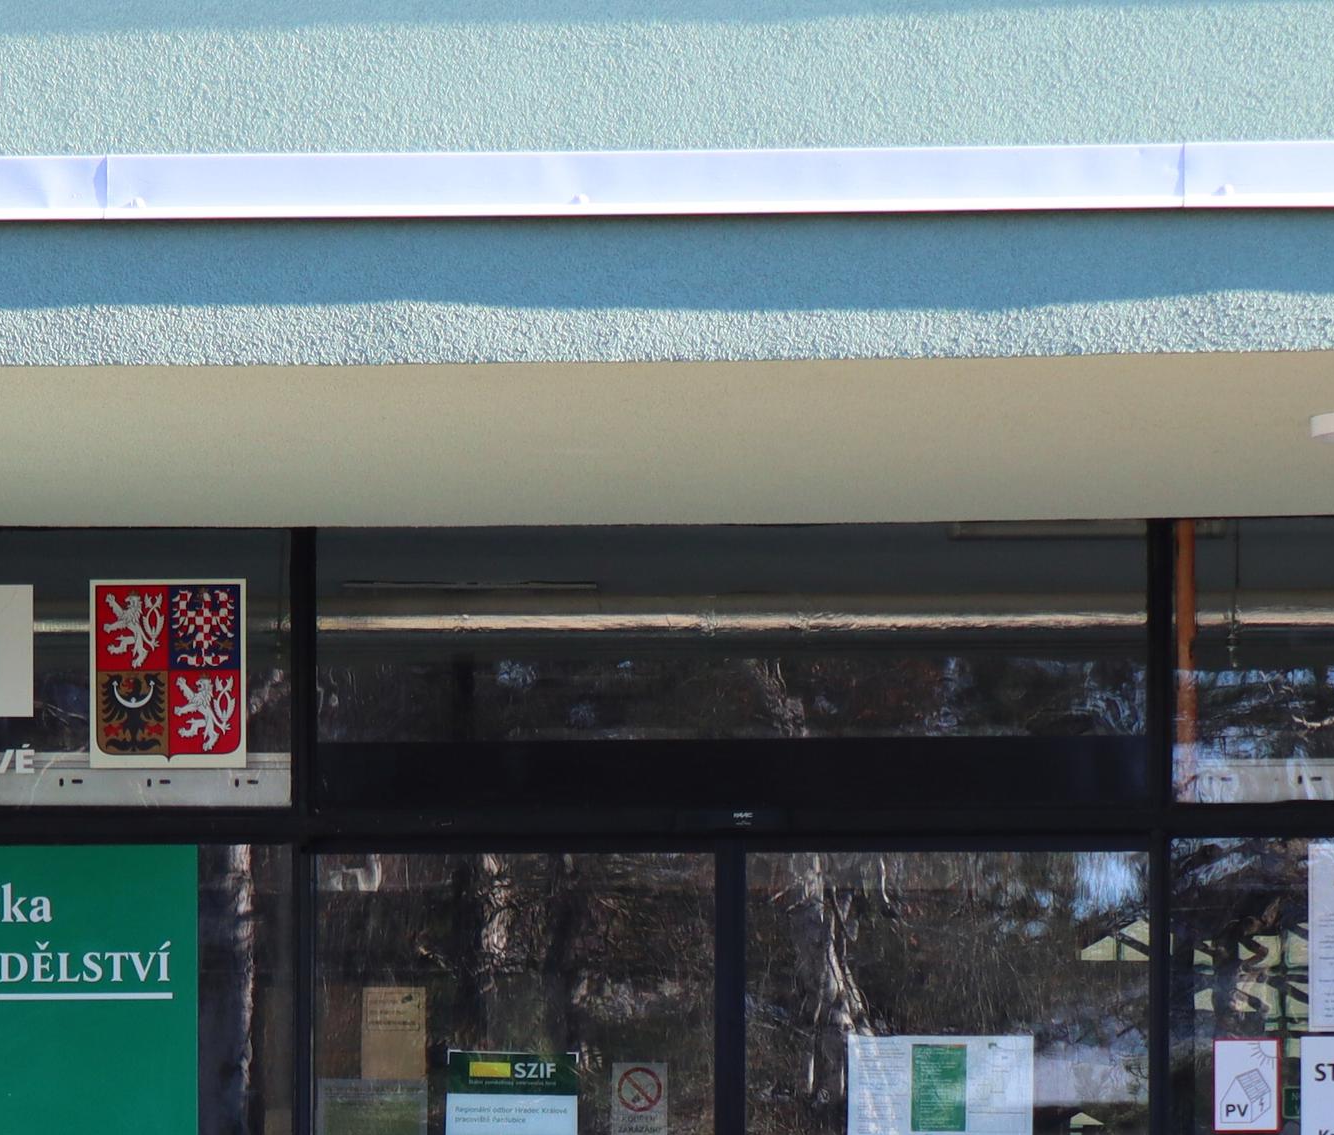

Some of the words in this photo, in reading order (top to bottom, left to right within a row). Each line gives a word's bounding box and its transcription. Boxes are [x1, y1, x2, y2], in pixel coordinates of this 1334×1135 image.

[514, 1062, 556, 1079] SZIF
[515, 1106, 539, 1114] Hradec
[1225, 1104, 1249, 1118] PV
